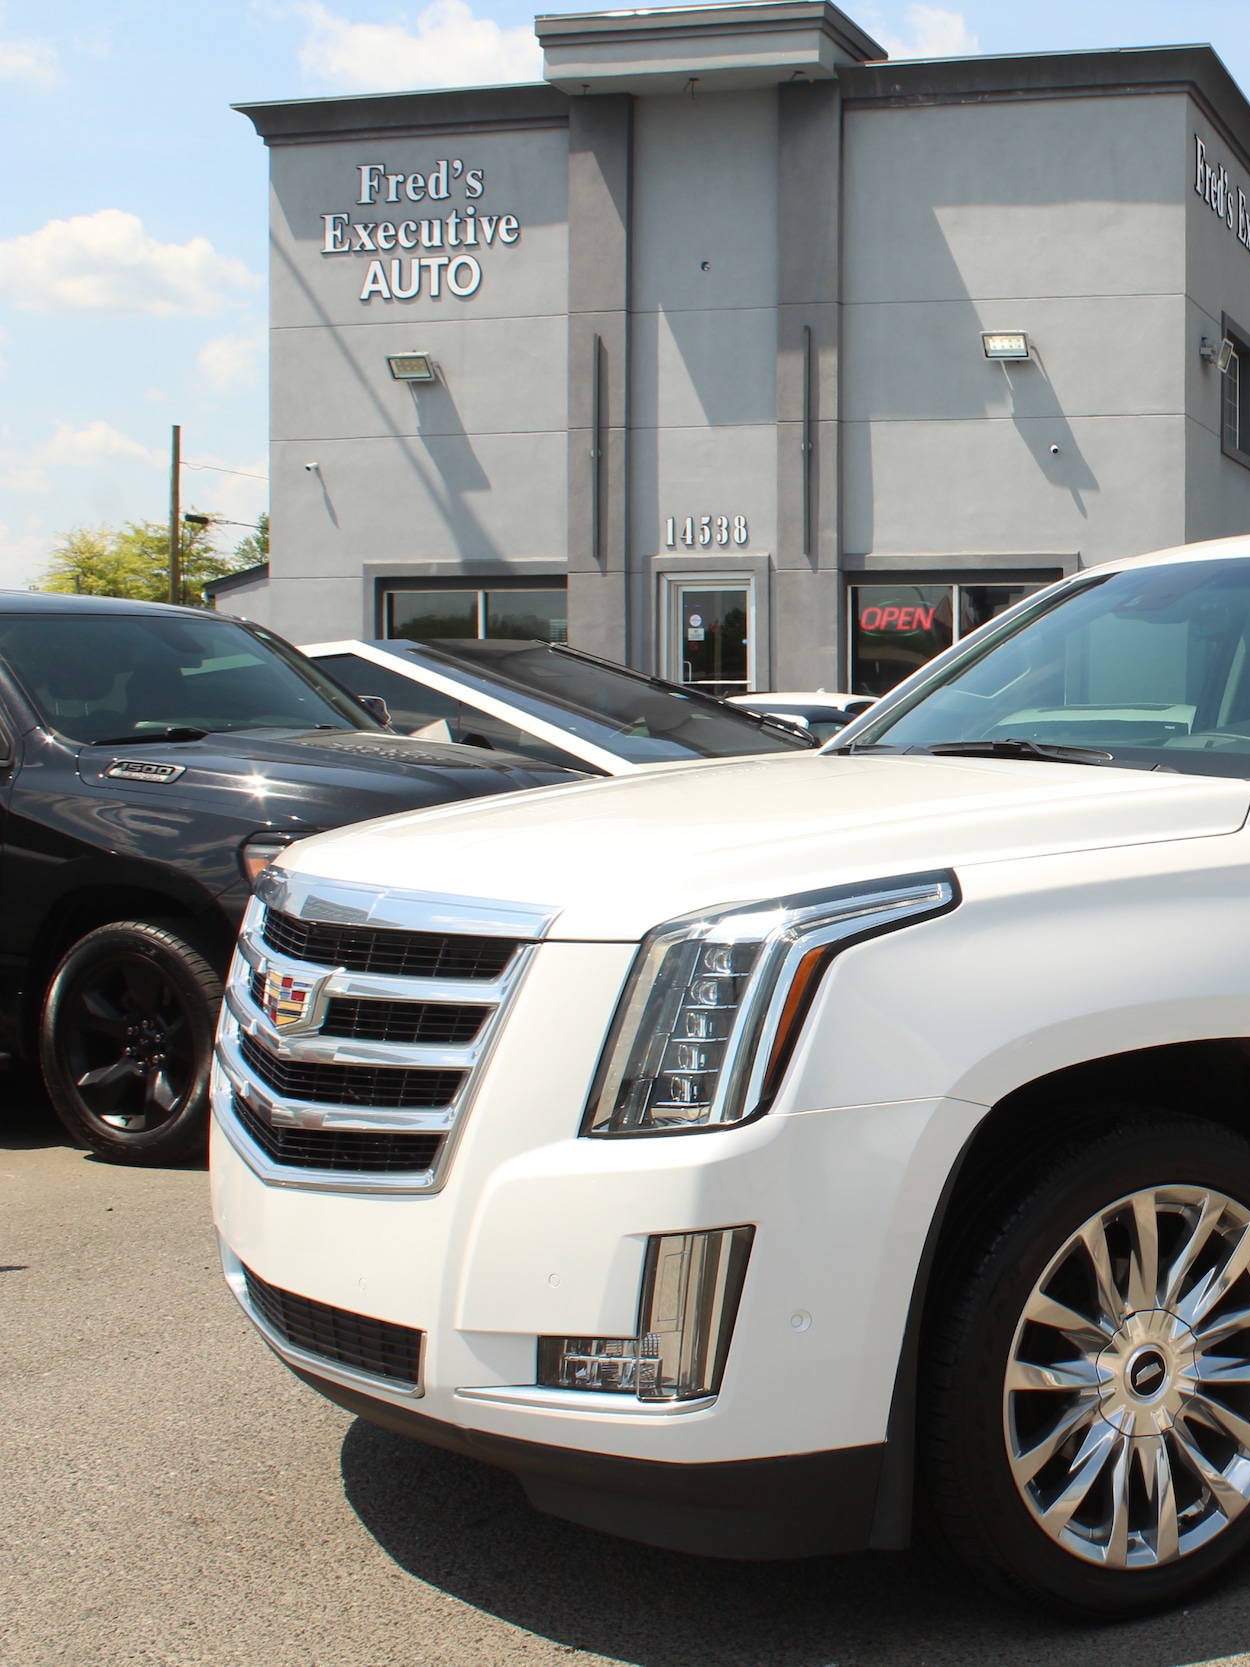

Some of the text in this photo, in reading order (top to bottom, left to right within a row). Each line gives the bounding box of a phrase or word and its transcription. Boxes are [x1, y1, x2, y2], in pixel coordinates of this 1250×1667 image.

[356, 159, 484, 205] Fred's
[1194, 133, 1235, 231] Fred's
[320, 205, 521, 255] Executive
[359, 254, 483, 301] AUTO
[665, 515, 749, 546] 14538
[860, 606, 936, 631] OPEN
[120, 762, 173, 776] 1500
